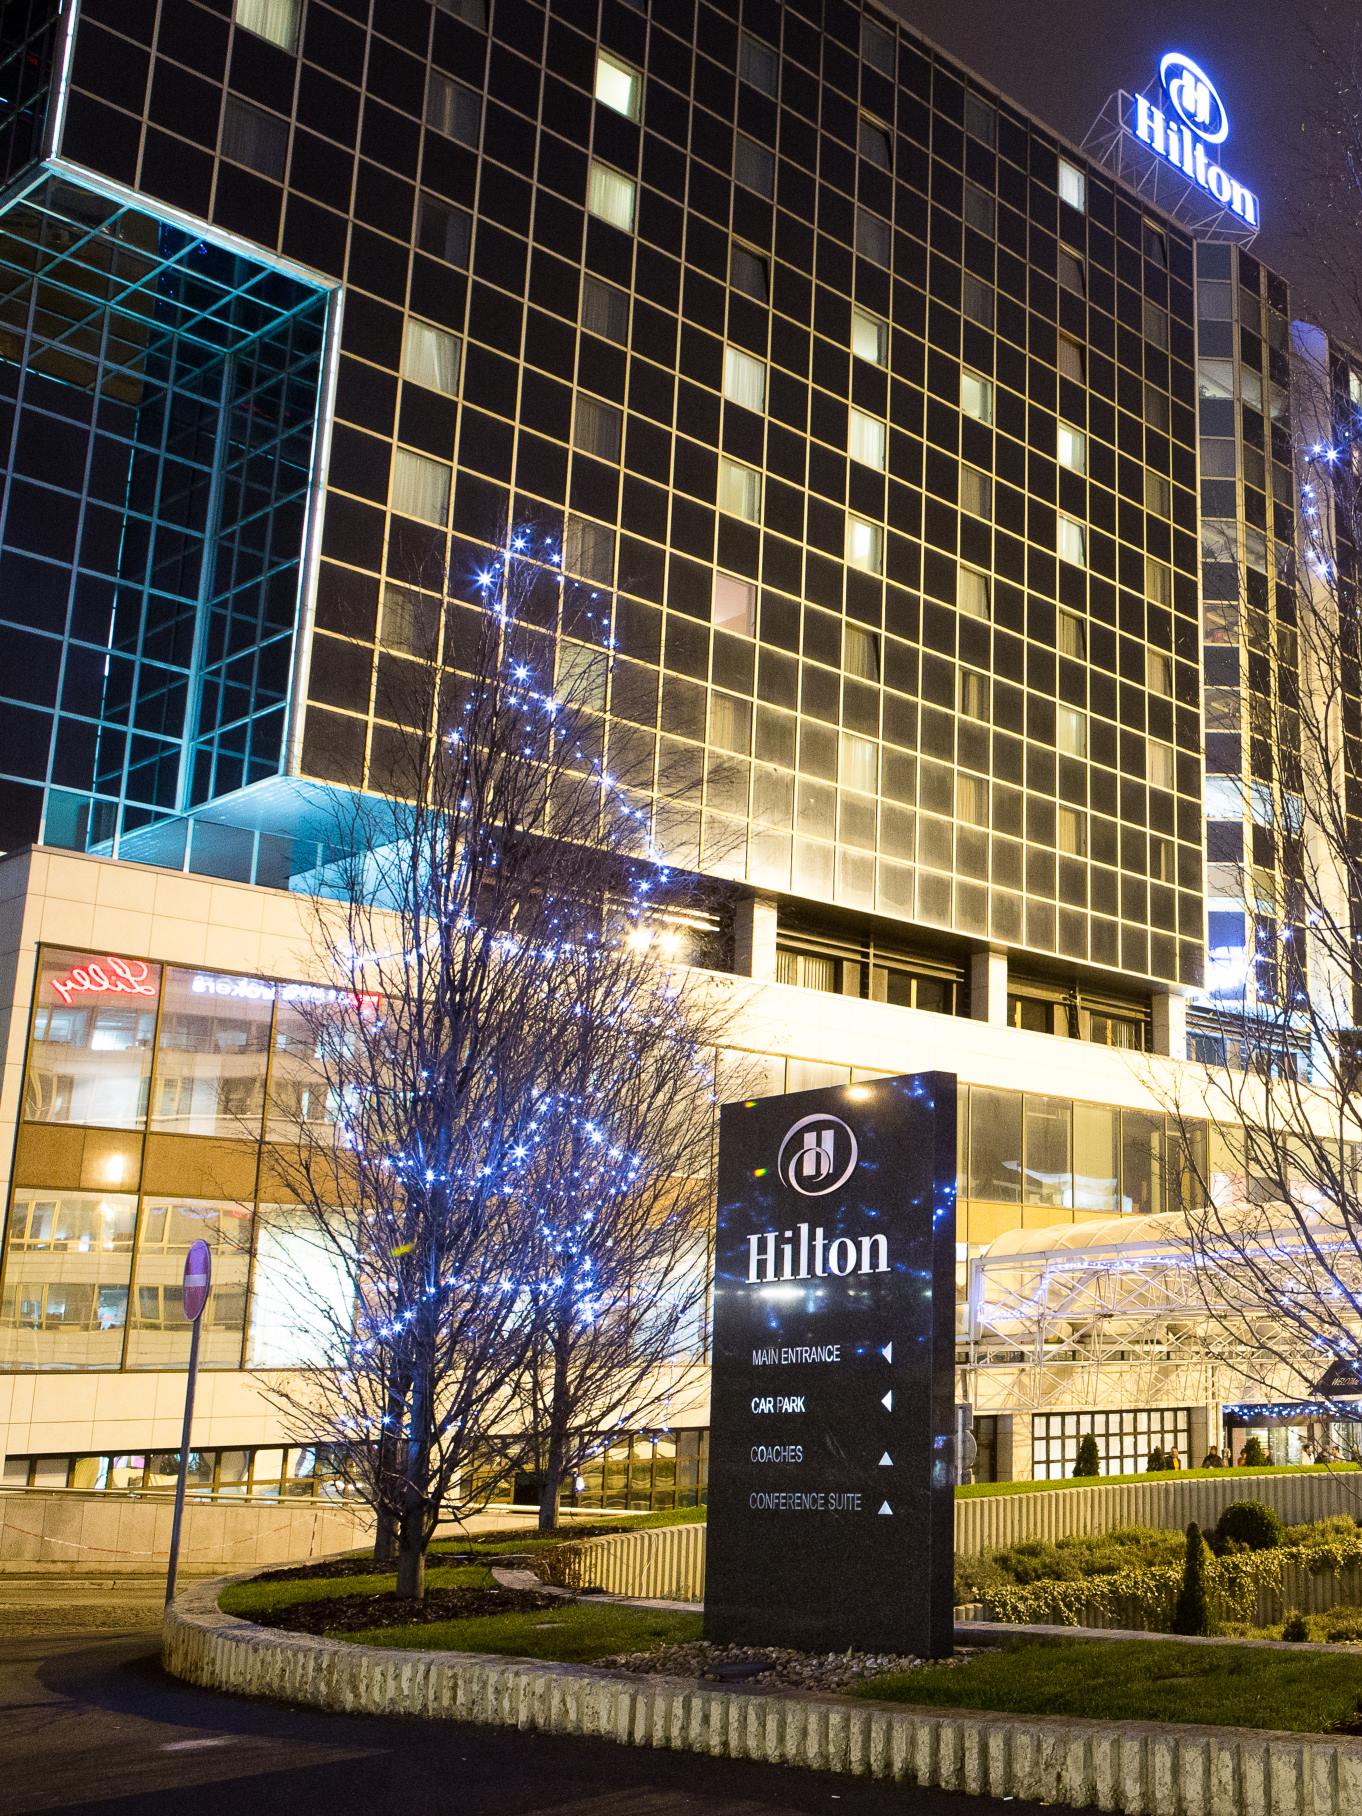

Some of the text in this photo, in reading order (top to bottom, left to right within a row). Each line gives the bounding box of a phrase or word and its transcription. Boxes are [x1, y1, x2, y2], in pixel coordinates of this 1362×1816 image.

[1134, 93, 1257, 226] Hilton
[745, 1223, 891, 1284] Hilton
[752, 1345, 841, 1366] MAIN ENTRANCE
[751, 1396, 806, 1414] CAR PARK
[751, 1446, 803, 1463] COACHES
[750, 1492, 862, 1511] CONFERENCE SUITE
